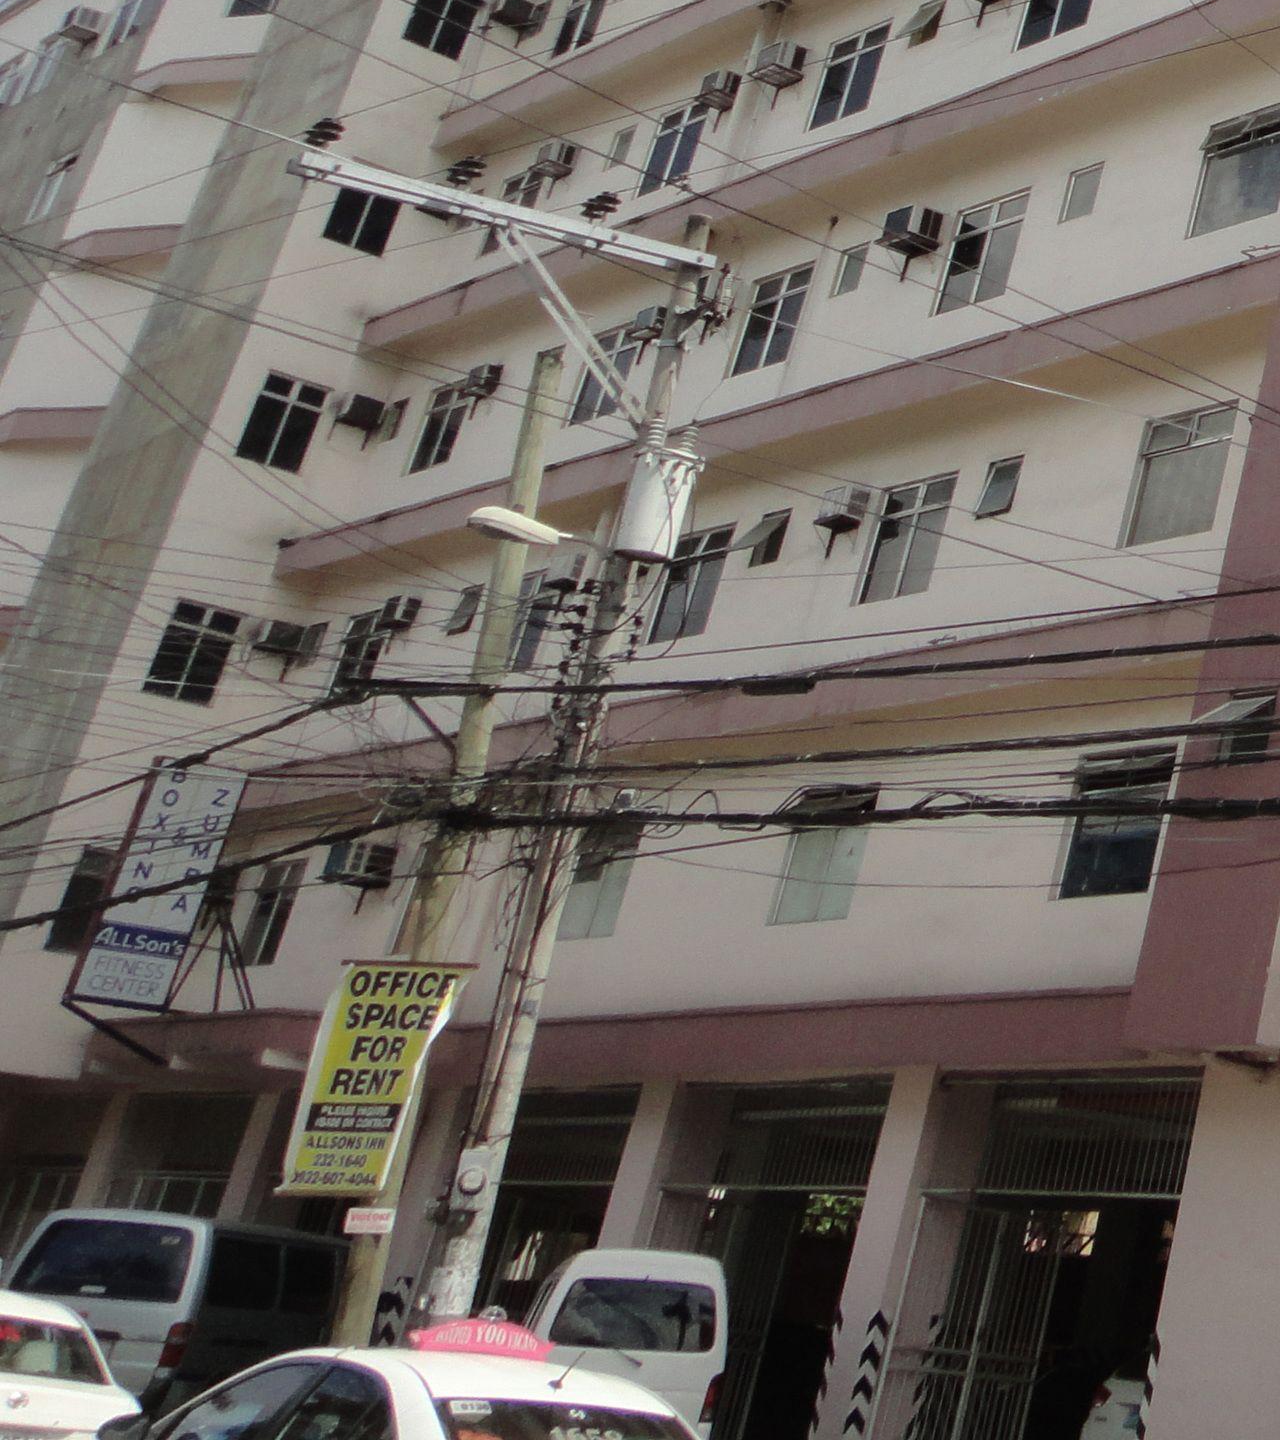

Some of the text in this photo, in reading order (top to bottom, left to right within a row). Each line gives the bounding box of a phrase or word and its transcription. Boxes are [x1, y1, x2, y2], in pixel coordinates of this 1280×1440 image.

[94, 925, 185, 955] ALLSon's
[93, 955, 166, 980] FITNESS
[89, 973, 161, 997] CENTER
[350, 970, 459, 998] OFFICE
[346, 1003, 440, 1031] SPACE
[351, 1036, 407, 1062] FOR
[329, 1068, 404, 1095] RENT
[306, 1135, 363, 1150] ALLSONS
